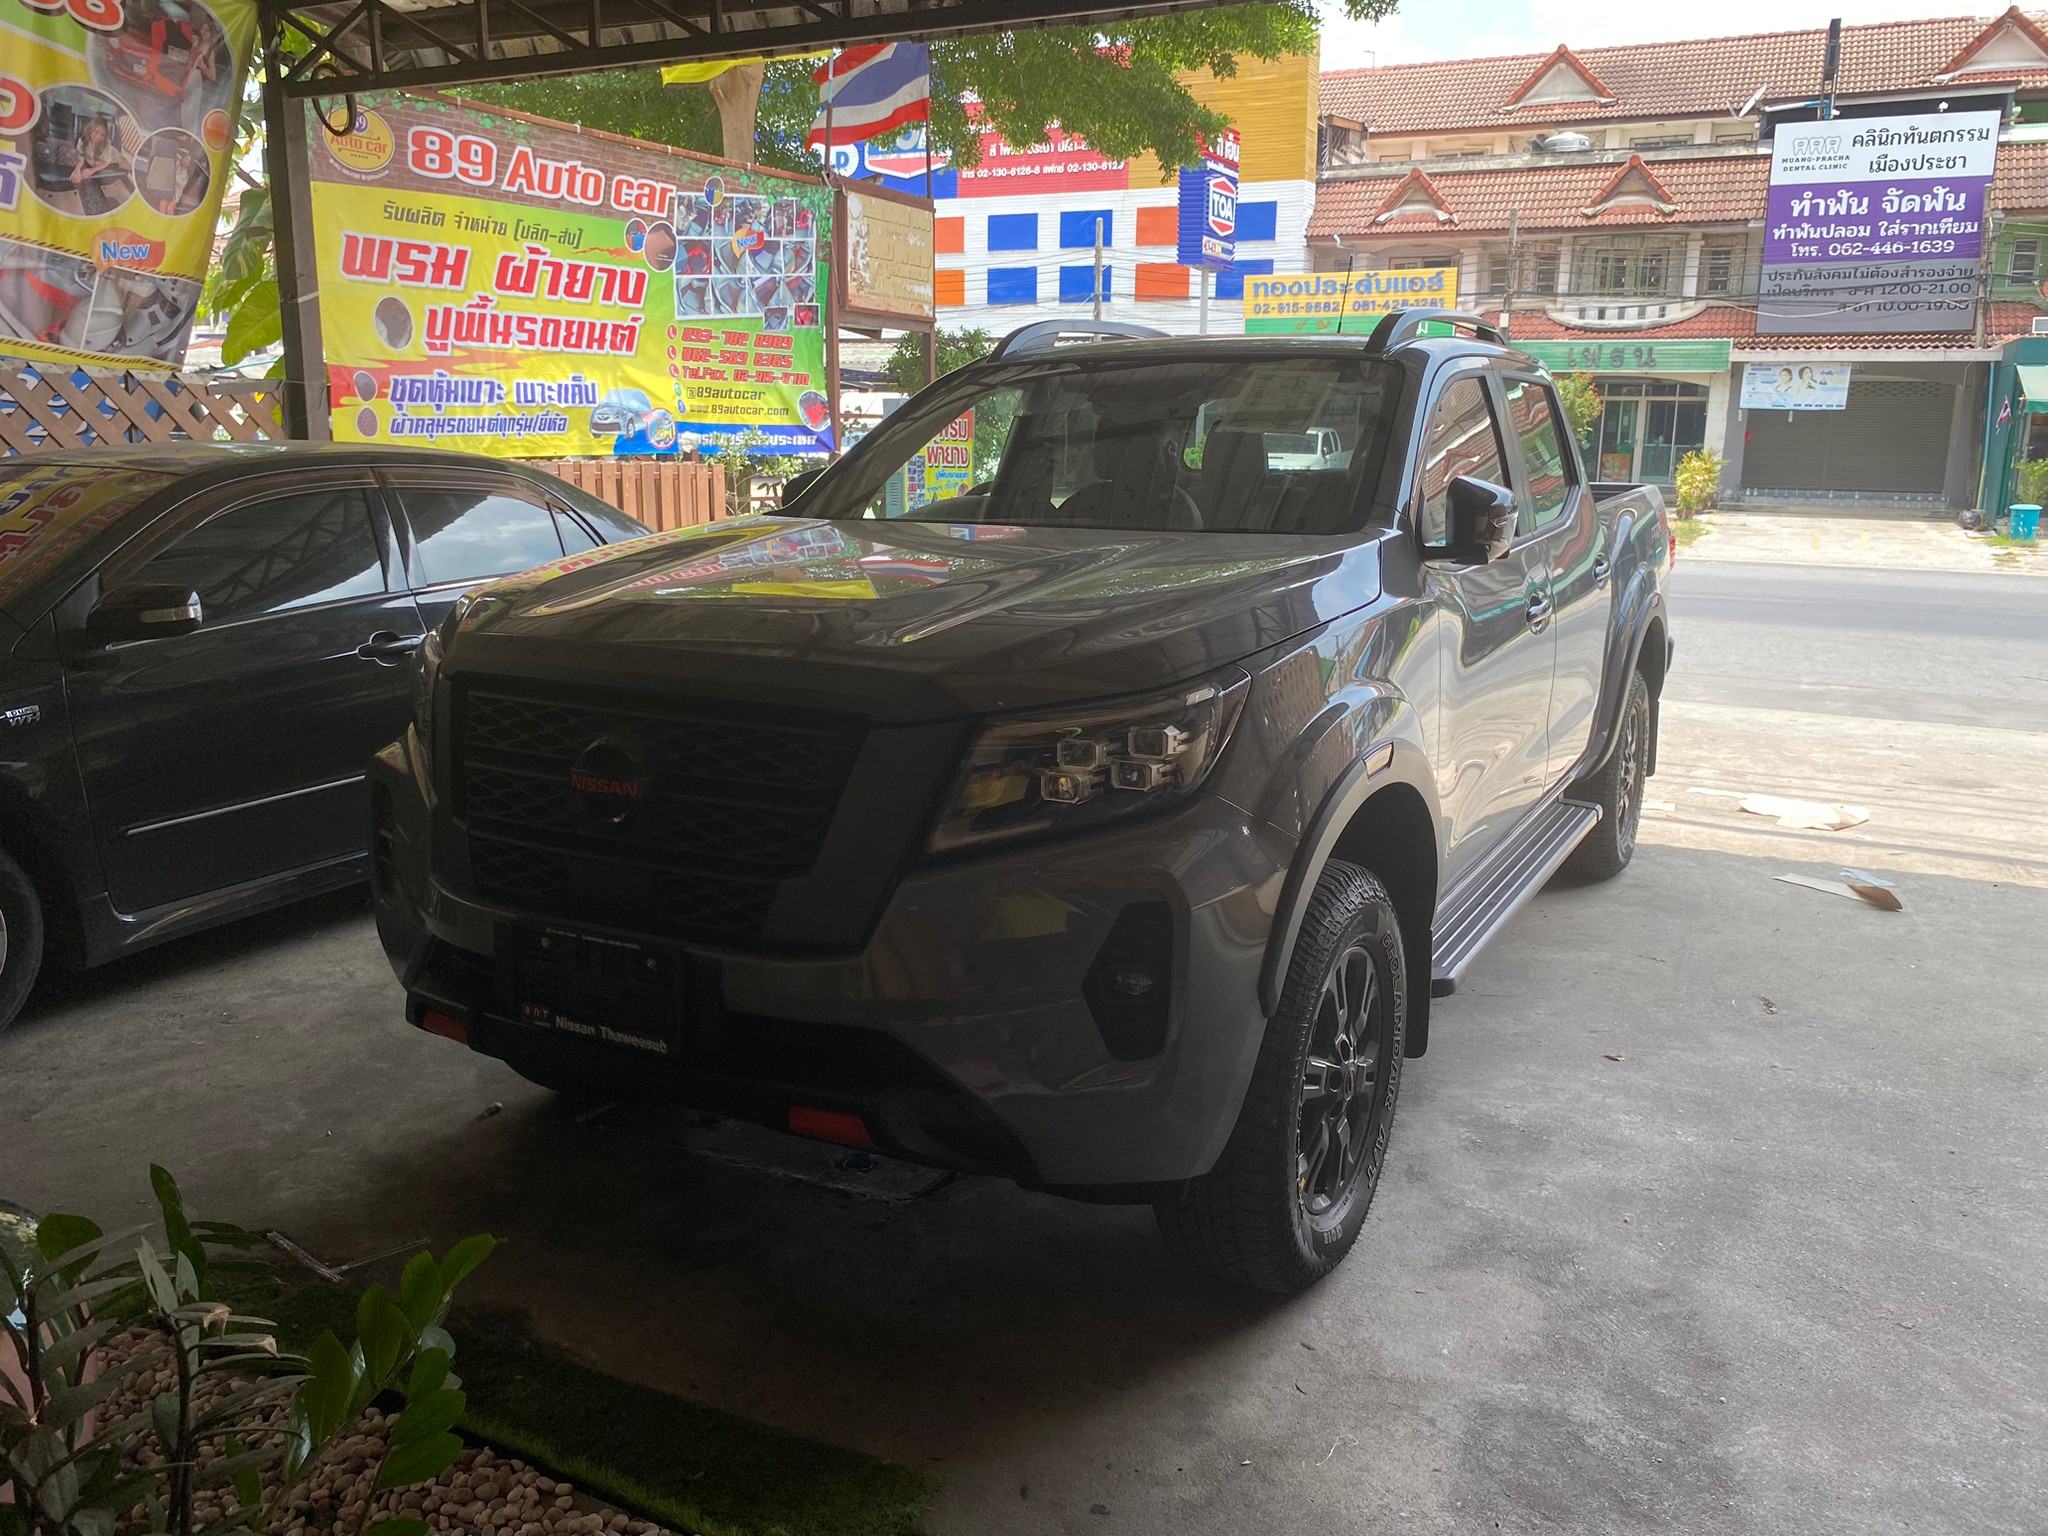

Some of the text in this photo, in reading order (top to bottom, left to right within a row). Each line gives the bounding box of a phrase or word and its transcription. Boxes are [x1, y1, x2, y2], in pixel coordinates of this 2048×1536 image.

[330, 133, 388, 155] Auto car
[1852, 125, 1990, 148] คลินิกทันตกรรม
[1781, 154, 1851, 164] MUANG-PRACHA
[1868, 153, 1967, 174] เมืองประชา
[408, 127, 497, 186] 89
[502, 146, 605, 206] Auto
[611, 175, 677, 217] car
[1212, 192, 1233, 221] TOA
[1790, 186, 1966, 218] ทำฟัน จัดฟัน
[383, 200, 446, 228] รับผลิต
[454, 211, 508, 236] จำหน่าย
[1772, 216, 1979, 240] ทำฟันปลอม ใส่รากเทียม
[101, 240, 150, 262] New
[736, 235, 758, 250] New
[1790, 240, 1955, 257] โทร. 062-446-1639
[340, 232, 649, 308] พรม ผ้ายาง
[1252, 271, 1445, 298] ทองประดับแอร์
[423, 295, 644, 355] ปูพื้นรถยนต์
[390, 371, 506, 412] ชุดหุ้มเบาะ
[687, 386, 766, 400] @89autocar
[689, 404, 789, 416] www.89autocar.com
[571, 773, 638, 797] NISSAN
[555, 1015, 596, 1036] Nissan
[1382, 931, 1402, 1111] GEOLANDAR
[1367, 1124, 1386, 1189] A/T
